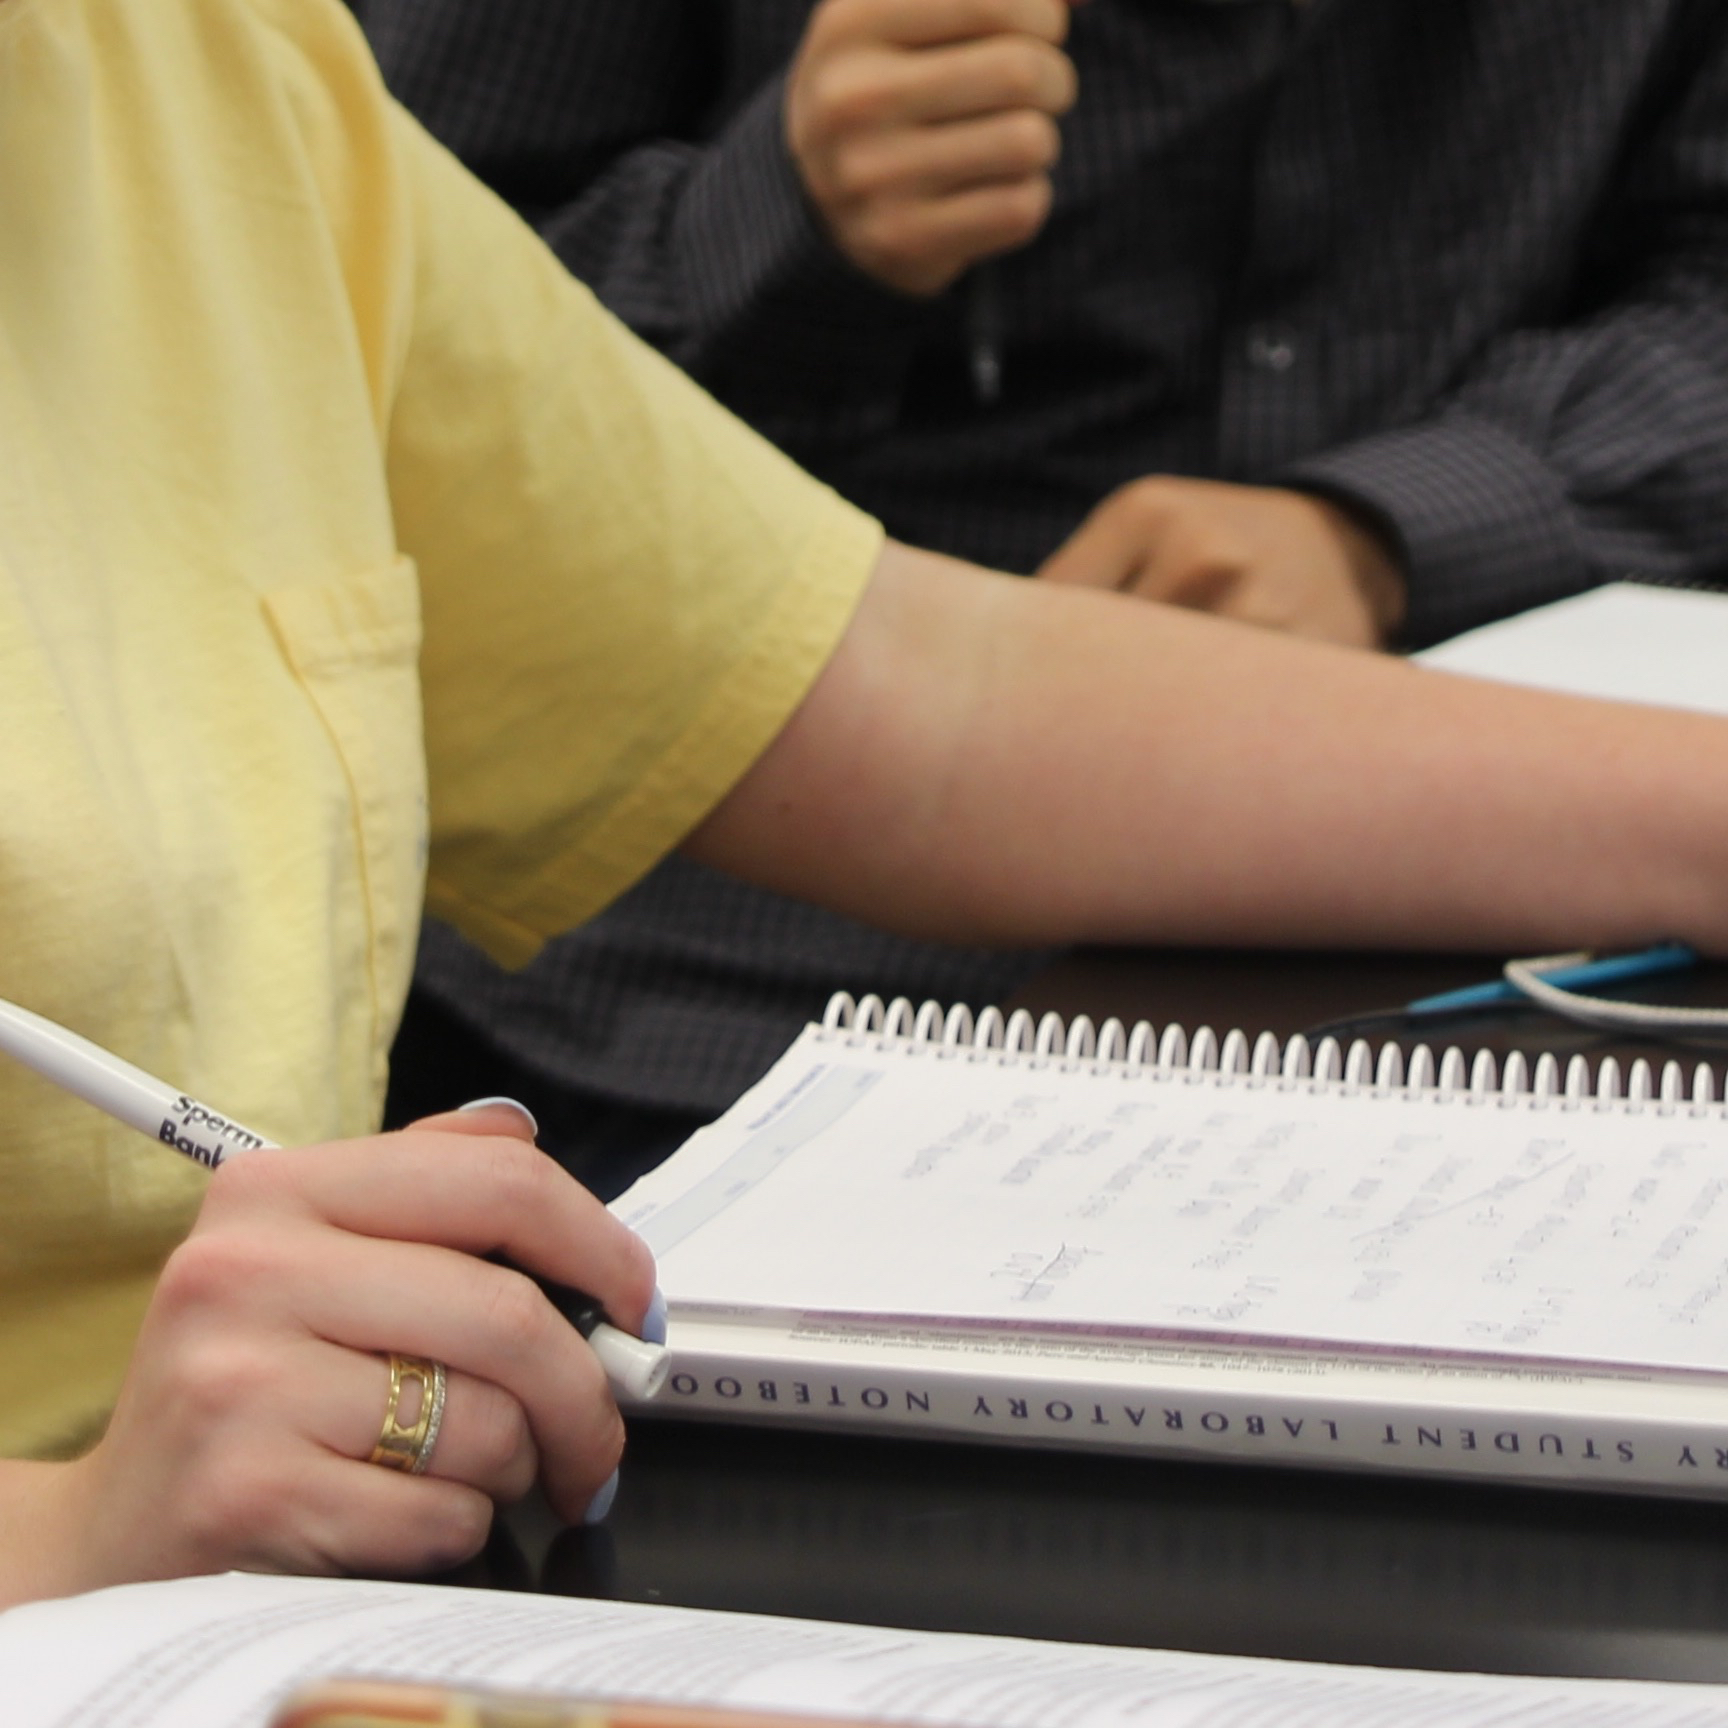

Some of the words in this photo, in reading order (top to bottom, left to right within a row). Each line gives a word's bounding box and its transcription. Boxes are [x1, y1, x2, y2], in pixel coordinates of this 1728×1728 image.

[171, 1095, 264, 1149] Sperm
[671, 1373, 931, 1413] NOTEBOO
[972, 1395, 1339, 1441] LABORATORY
[1381, 1423, 1636, 1463] STUDENT
